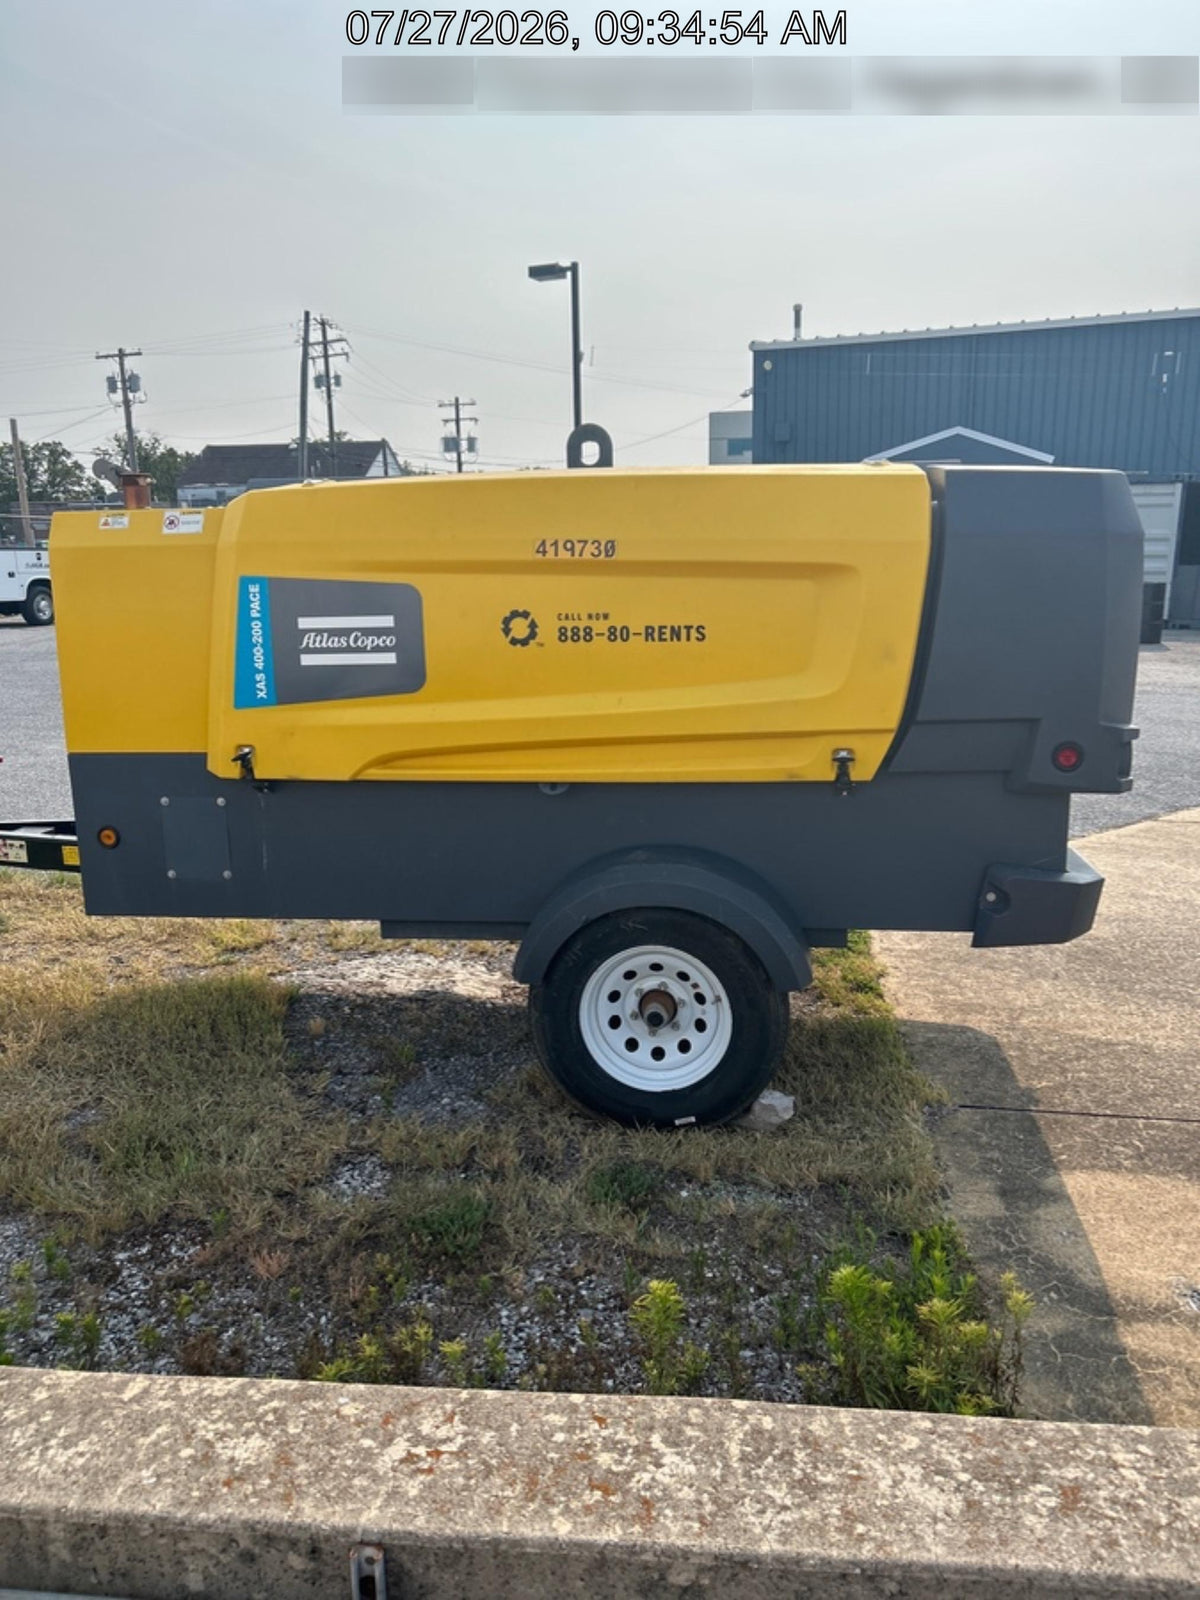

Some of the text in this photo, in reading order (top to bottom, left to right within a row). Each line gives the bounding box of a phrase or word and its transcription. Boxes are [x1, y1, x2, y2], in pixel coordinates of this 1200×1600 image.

[535, 539, 617, 559] 419730
[557, 613, 610, 622] CALL NOW
[248, 584, 268, 699] XAS 400-200 PACE
[299, 630, 397, 651] Atlas Copco
[557, 624, 707, 644] 888-80-RENTS
